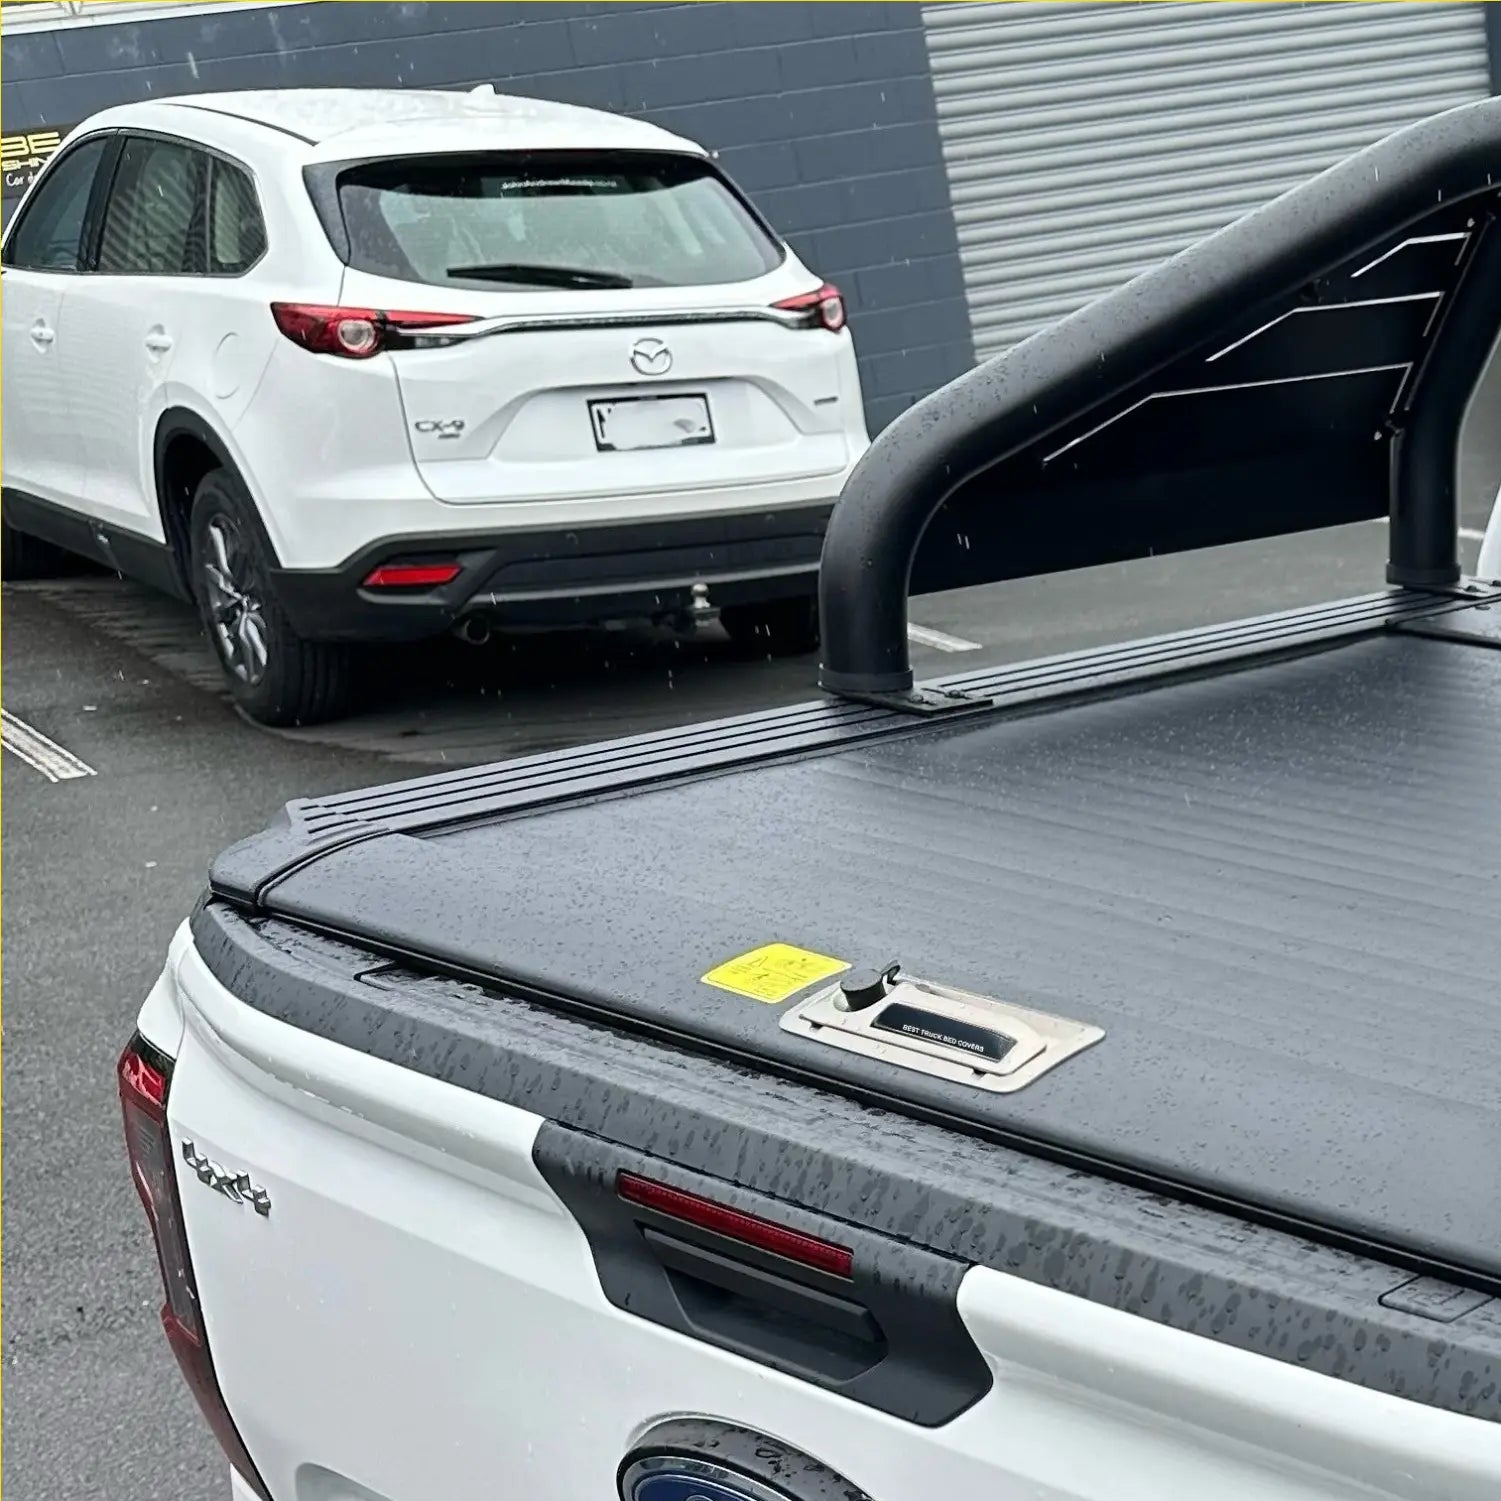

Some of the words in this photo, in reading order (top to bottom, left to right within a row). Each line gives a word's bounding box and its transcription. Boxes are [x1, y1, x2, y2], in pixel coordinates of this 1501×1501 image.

[415, 419, 465, 432] CX-9
[902, 1024, 920, 1034] BEST
[921, 1029, 942, 1041] TRUCK
[943, 1035, 957, 1045] BED
[958, 1040, 984, 1053] COVERS
